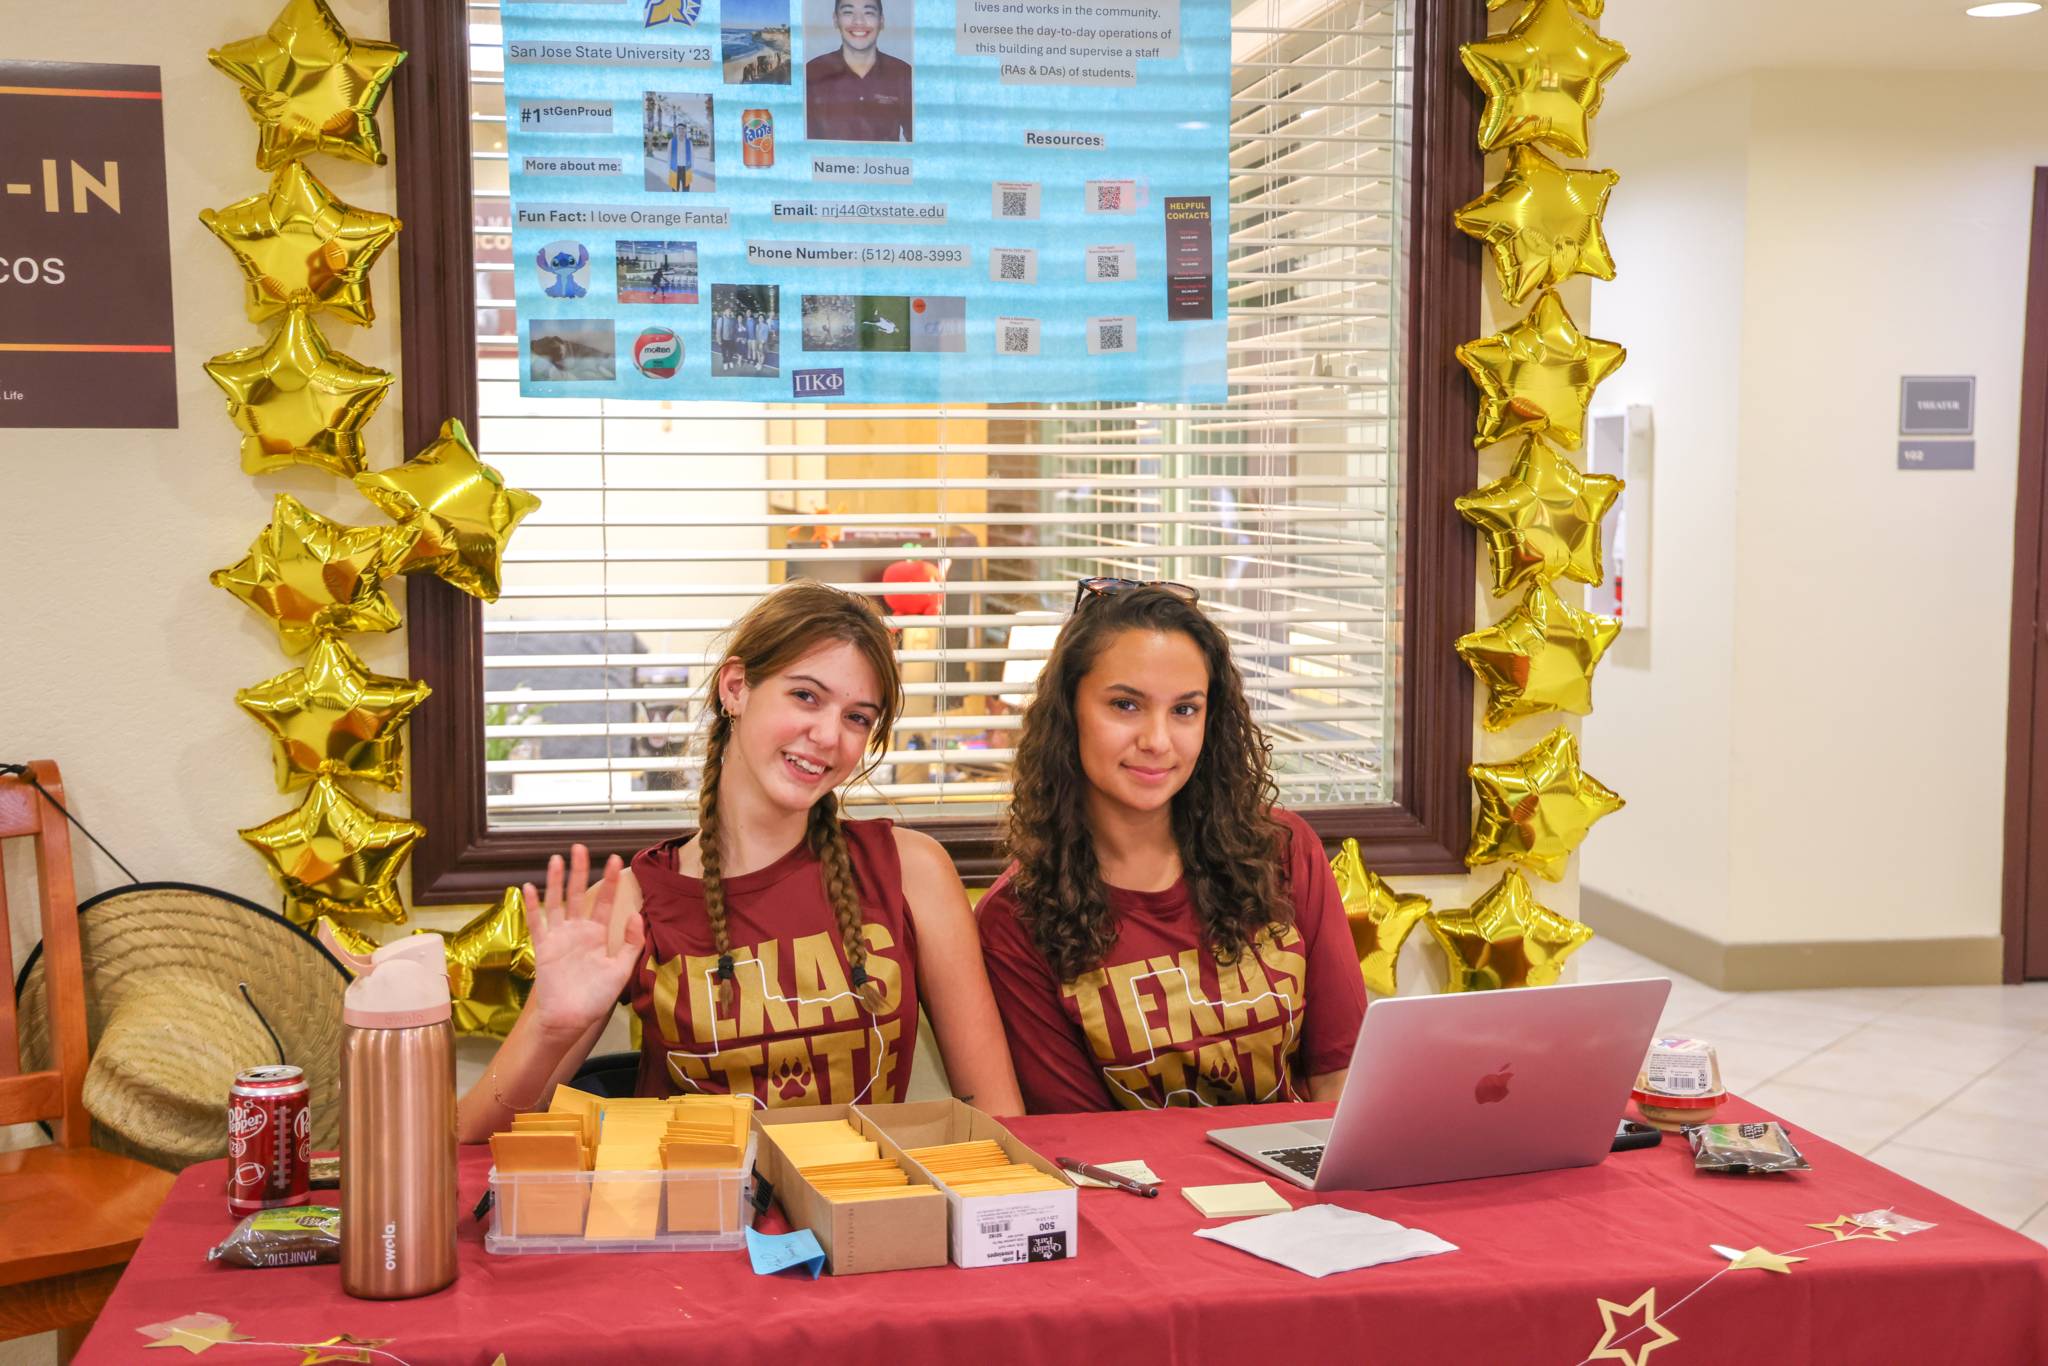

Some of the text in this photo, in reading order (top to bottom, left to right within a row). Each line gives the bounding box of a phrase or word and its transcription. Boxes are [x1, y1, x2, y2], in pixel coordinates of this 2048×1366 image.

[974, 1, 1161, 19] lives and works in the community.
[969, 25, 1014, 35] oversee
[1016, 25, 1034, 36] the
[1036, 25, 1096, 39] day-to-day
[1099, 28, 1158, 41] operations
[1160, 28, 1172, 40] of
[510, 45, 711, 62] San Jose State University '23
[975, 42, 1160, 60] this building and supervise a staff
[1000, 64, 1134, 79] (RAs & DAs) of students.
[1026, 133, 1104, 147] Resources:
[526, 160, 622, 173] More about me:
[814, 161, 910, 176] Name: Joshua
[774, 204, 944, 219] Email: nrj44@txstate.edu
[1169, 202, 1206, 210] HELPFUL
[518, 210, 546, 223] Fun
[550, 210, 587, 223] Fact:
[597, 211, 627, 224] love
[630, 211, 681, 226] Orange
[684, 212, 728, 225] Fanta!
[1166, 212, 1210, 220] CONTACTS
[748, 246, 962, 263] Phone Number: (512) 408-3993
[4, 390, 24, 400] Life
[646, 923, 902, 1044] TEXAS
[1061, 921, 1306, 1060] TEXAS
[1039, 1221, 1055, 1231] 500
[1031, 1242, 1062, 1255] Quality
